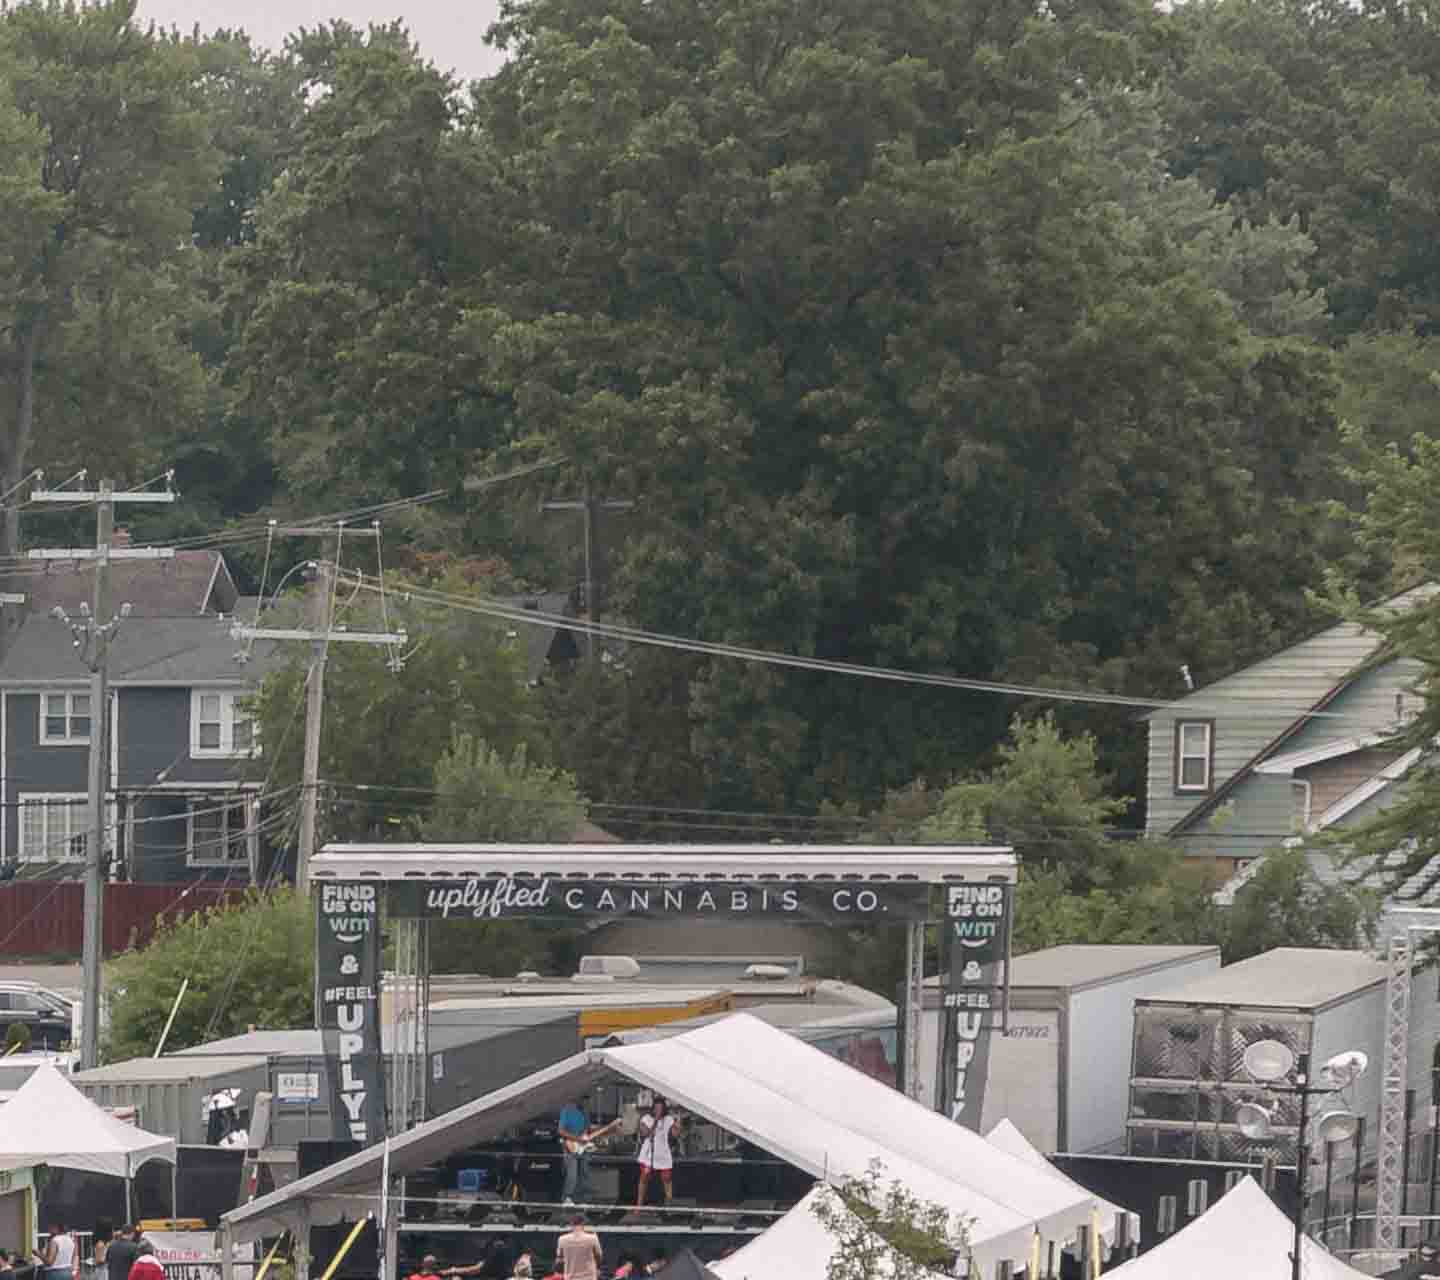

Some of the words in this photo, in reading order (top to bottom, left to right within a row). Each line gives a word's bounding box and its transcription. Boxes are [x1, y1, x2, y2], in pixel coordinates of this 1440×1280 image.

[322, 885, 375, 900] FIND
[427, 879, 551, 918] uplyfted
[564, 889, 799, 913] CANNABIS
[832, 890, 888, 913] CO.
[949, 886, 1003, 903] FIND
[322, 900, 348, 913] US
[350, 900, 376, 913] ON
[948, 903, 972, 917] US
[974, 903, 1003, 917] ON
[329, 918, 370, 933] wm
[953, 920, 997, 937] wm
[339, 954, 360, 975] &
[962, 960, 982, 981] &
[325, 986, 377, 1001] #FEEL
